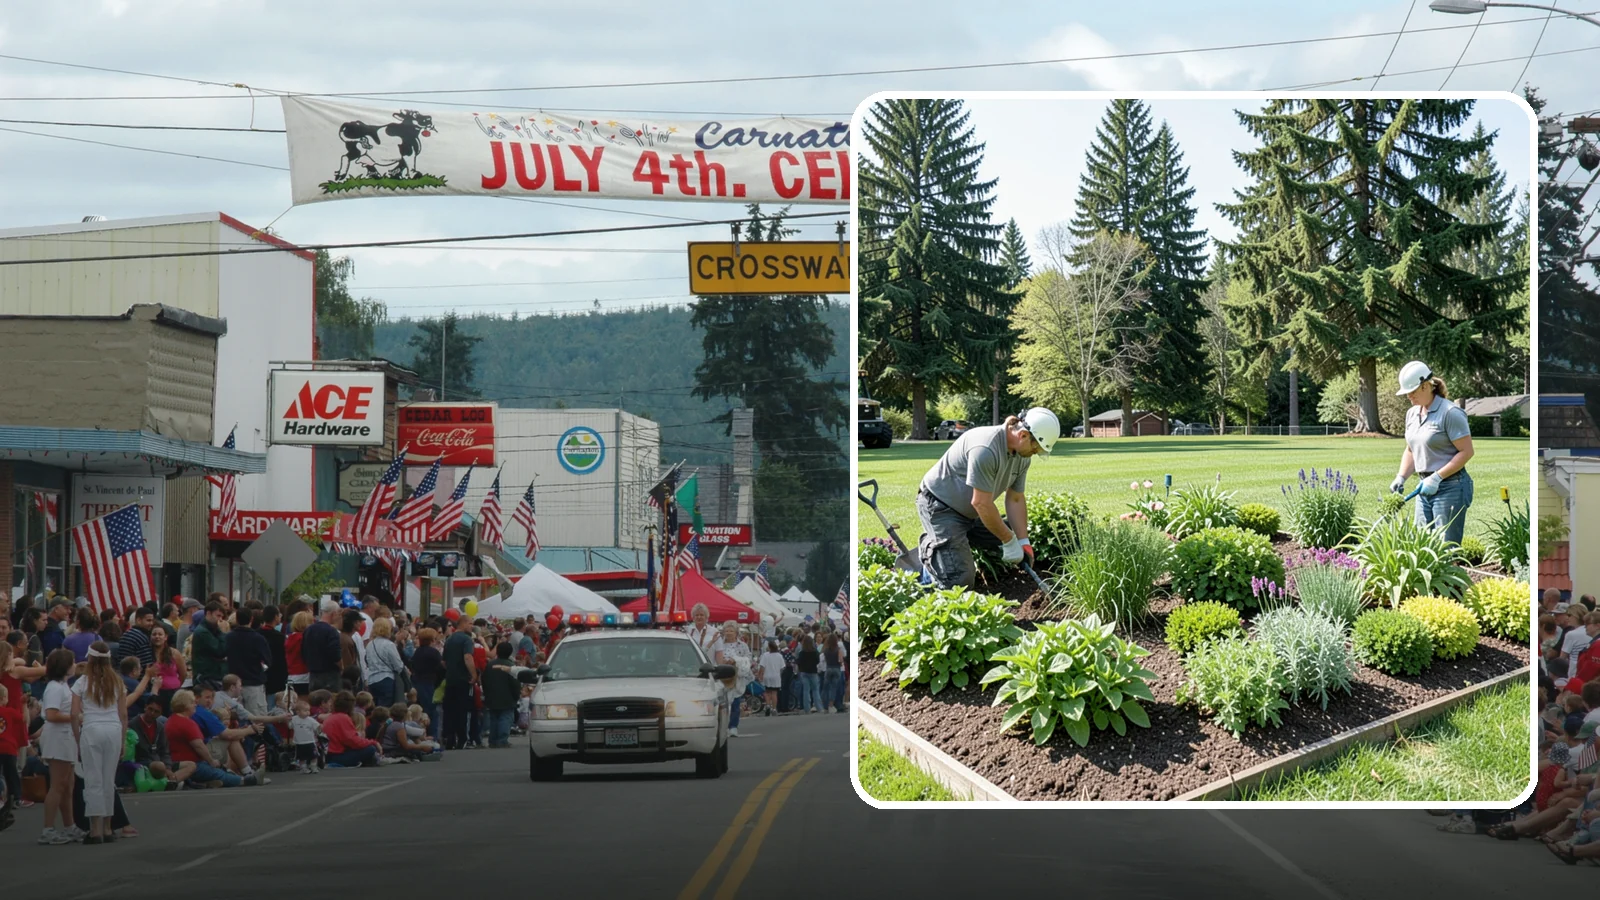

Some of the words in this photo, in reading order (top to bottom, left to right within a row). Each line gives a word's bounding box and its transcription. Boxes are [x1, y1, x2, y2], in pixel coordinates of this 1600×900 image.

[695, 121, 850, 149] Carnat
[481, 140, 605, 193] JULY
[632, 149, 746, 198] 4th.
[696, 253, 850, 280] CROSSWA
[282, 380, 374, 420] ACE
[405, 409, 453, 422] CEDAR
[283, 420, 371, 437] Hardware
[416, 428, 477, 447] Coca-Cola
[83, 484, 94, 494] St.
[96, 485, 124, 495] Vincent
[126, 485, 136, 495] de
[137, 485, 155, 495] Paul
[688, 526, 741, 534] CRNATION
[699, 535, 730, 543] GLASS
